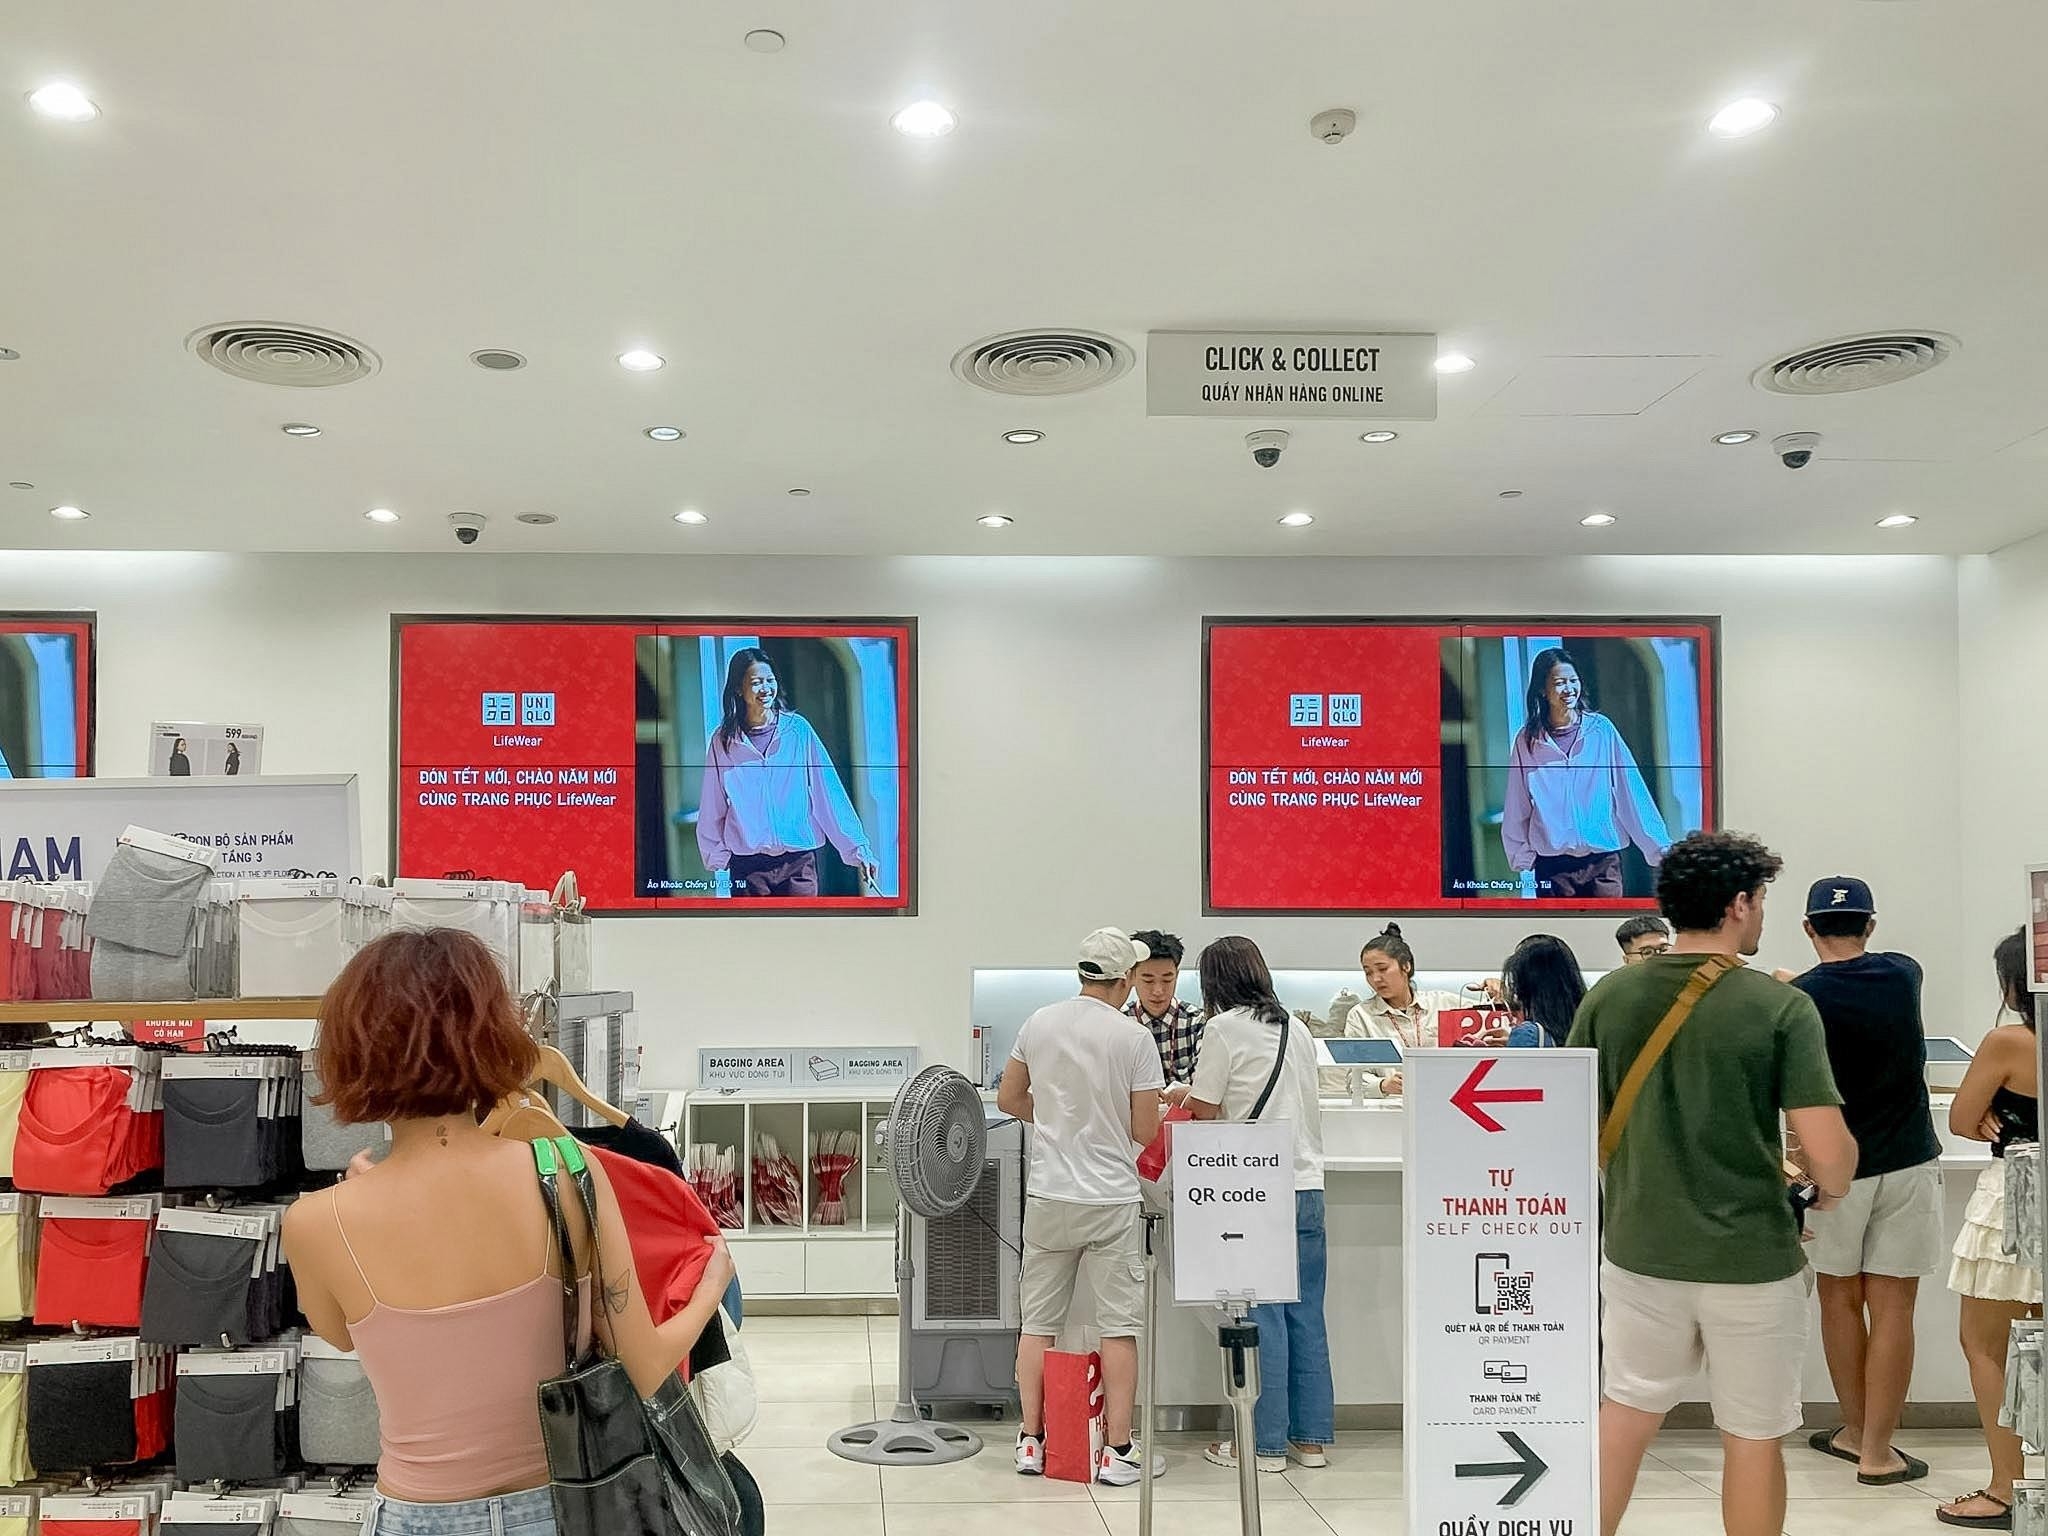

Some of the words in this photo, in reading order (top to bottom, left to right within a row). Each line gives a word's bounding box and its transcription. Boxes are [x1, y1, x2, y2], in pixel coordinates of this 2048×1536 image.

[1205, 346, 1265, 371] CLICK
[1271, 347, 1287, 371] &
[1293, 348, 1380, 371] COLLECT
[1245, 383, 1283, 404] NHẬN
[1289, 383, 1327, 402] HÀNG
[1332, 386, 1384, 402] ONLINE
[225, 727, 242, 739] 599
[493, 735, 543, 747] LifeWear
[1301, 736, 1350, 748] LifeWear
[419, 767, 448, 785] ĐÓN
[452, 766, 479, 785] TẾT
[516, 767, 553, 785] CHÀO
[558, 767, 589, 785] NĂM
[593, 767, 617, 785] MỚI
[1229, 768, 1257, 785] ĐÓN
[1261, 767, 1288, 785] TẾT
[1323, 768, 1360, 785] CHÀO
[1365, 768, 1395, 785] NĂM
[1399, 768, 1423, 785] MỚI
[419, 789, 457, 806] CÙNG
[461, 792, 510, 806] TRANG
[514, 792, 552, 809] PHỤC
[557, 792, 617, 806] LifeWear
[1229, 790, 1266, 806] CÙNG
[1271, 793, 1318, 806] TRANG
[1322, 793, 1360, 809] PHỤC
[1364, 793, 1423, 807] LifeWear
[0, 836, 82, 881] AM
[187, 852, 194, 860] S
[256, 852, 263, 863] 3
[237, 870, 245, 879] AT
[248, 870, 261, 878] THE
[710, 1058, 753, 1068] BAGGING
[757, 1058, 785, 1068] AREA
[1187, 1154, 1239, 1167] Credit
[1243, 1154, 1279, 1167] card
[1488, 1168, 1514, 1191] TỰ
[1188, 1188, 1216, 1206] QR
[1222, 1187, 1266, 1203] code
[1442, 1198, 1508, 1216] THANH
[1516, 1192, 1567, 1216] TOÁN
[233, 1227, 239, 1235] L
[1426, 1223, 1471, 1236] SELF
[1482, 1222, 1539, 1236] CHECK
[1550, 1221, 1583, 1235] OUT
[1484, 1324, 1496, 1333] QR
[1512, 1323, 1540, 1332] THANH
[1478, 1336, 1490, 1345] QR
[1493, 1335, 1531, 1344] PAYMENT
[1469, 1394, 1498, 1403] THANH
[1473, 1407, 1496, 1415] CARD
[1499, 1406, 1537, 1415] PAYMENT
